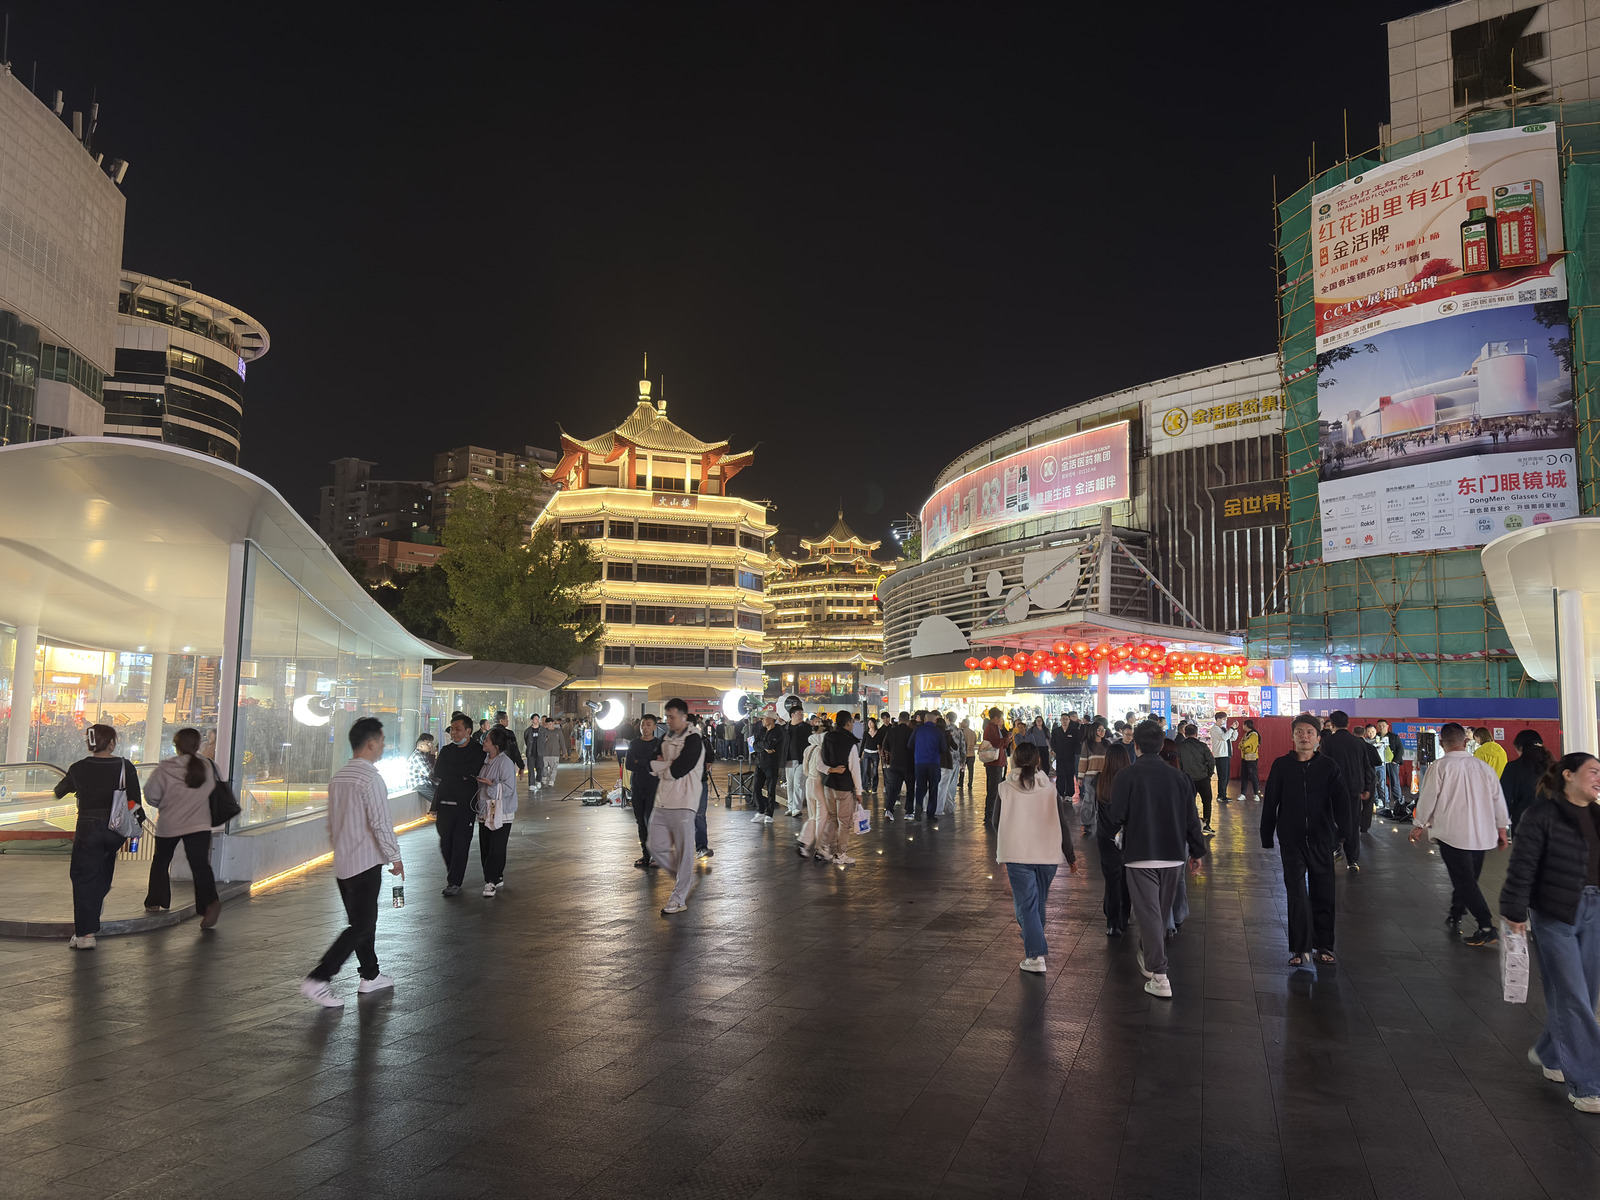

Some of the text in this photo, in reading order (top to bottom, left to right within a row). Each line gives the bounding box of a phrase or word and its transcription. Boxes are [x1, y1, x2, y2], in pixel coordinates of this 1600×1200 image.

[1319, 170, 1480, 243] 红花油里有红花
[1337, 201, 1357, 212] IMADA
[1358, 196, 1370, 204] RED
[1371, 186, 1398, 199] FLOWER
[1333, 225, 1389, 260] 金活牌
[1321, 251, 1431, 294] 全国各连锁药店均有销售
[1061, 451, 1111, 472] 金活医药集团
[1075, 475, 1116, 495] 金活相伴
[1457, 470, 1567, 495] 东门眼镜城
[1469, 496, 1505, 504] DongMen
[1234, 695, 1243, 704] 19
